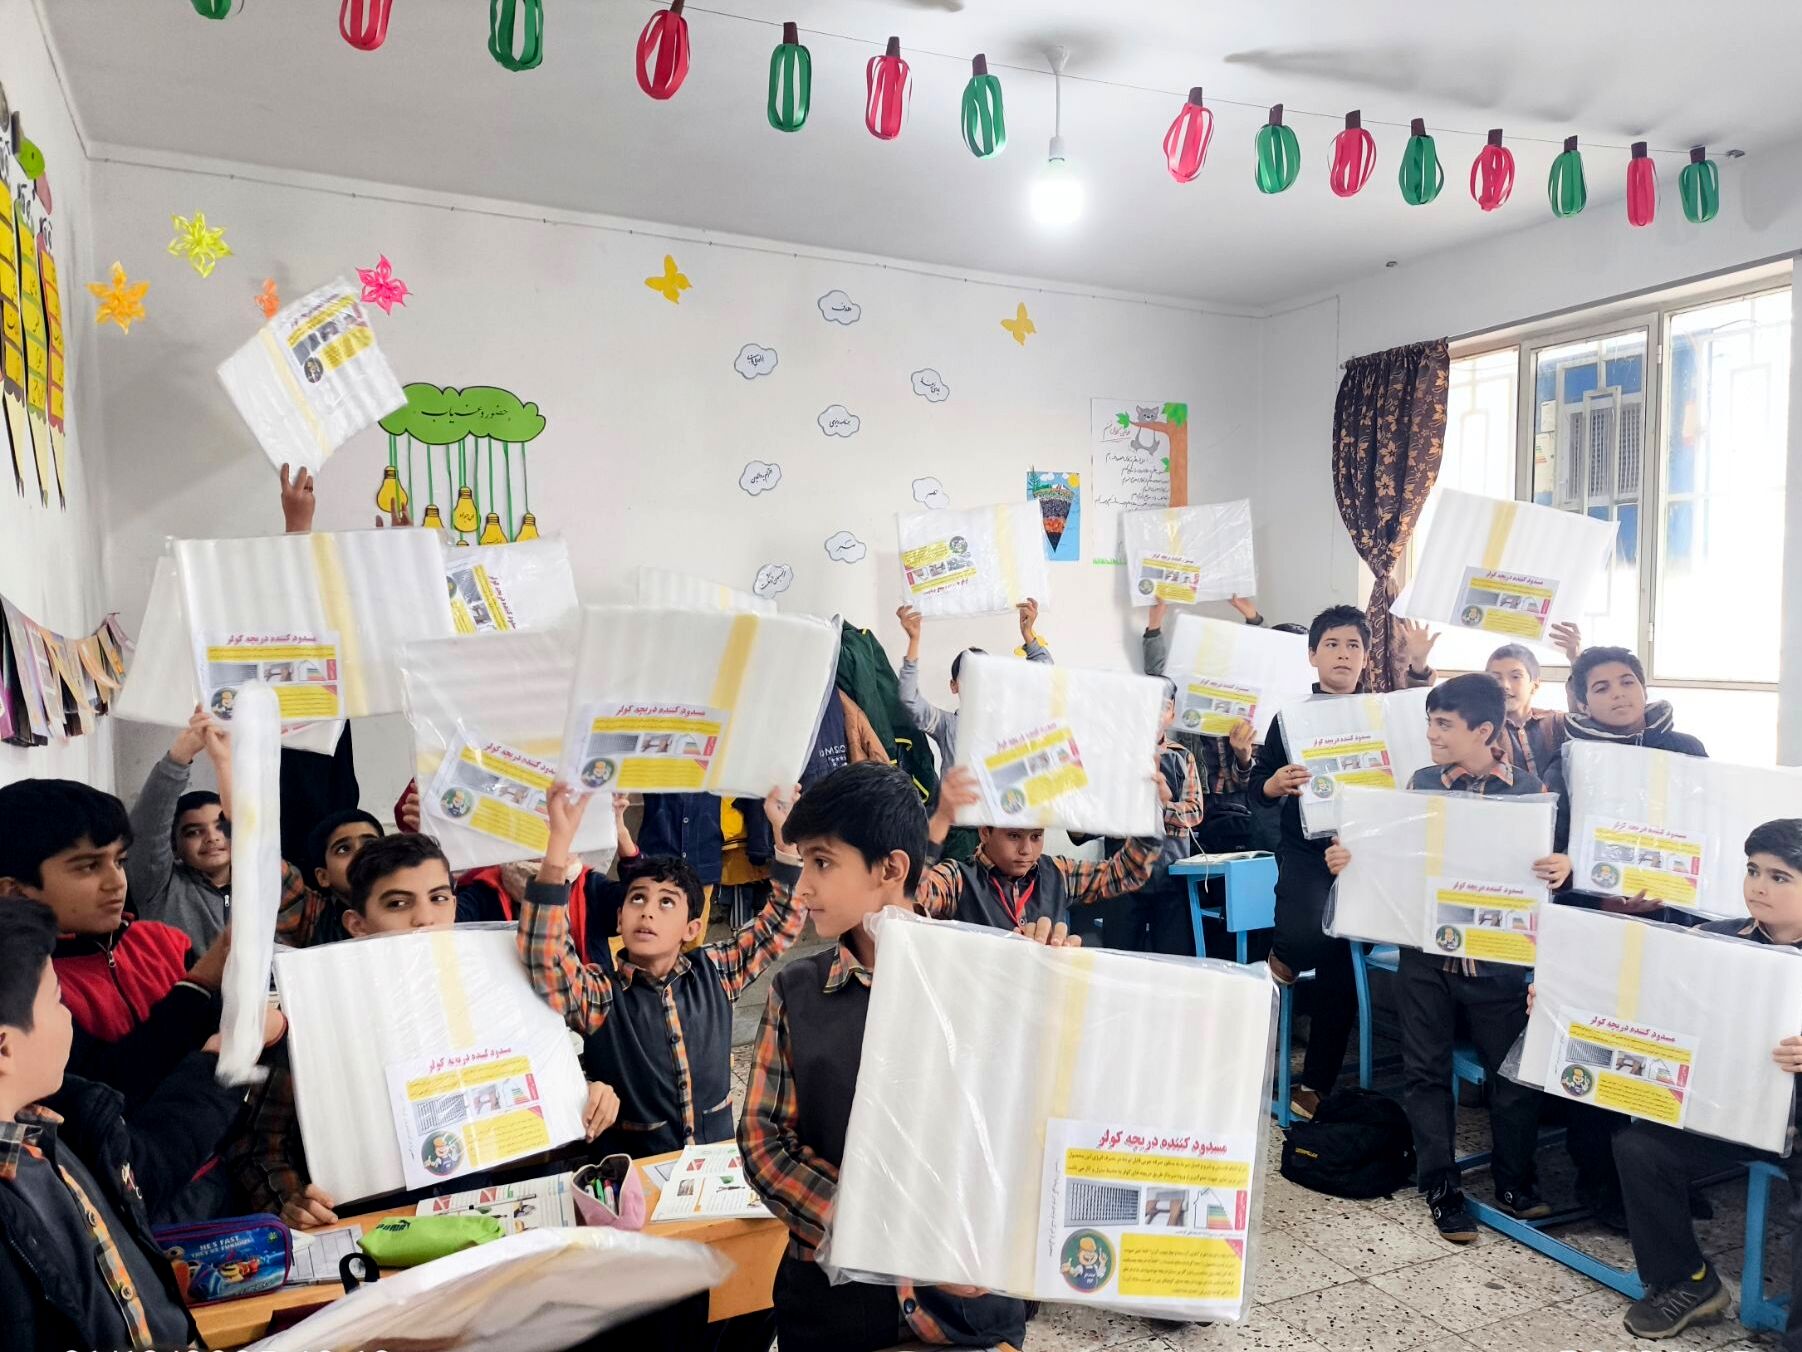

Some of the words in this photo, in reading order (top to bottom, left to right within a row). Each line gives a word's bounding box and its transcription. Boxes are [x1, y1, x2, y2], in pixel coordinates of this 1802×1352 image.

[616, 704, 633, 716] کولر
[634, 705, 657, 716] دریچه
[658, 706, 680, 715] کننده
[681, 709, 705, 721] مسدود
[1590, 1016, 1607, 1027] کولر
[1608, 1021, 1629, 1032] دریچه
[1629, 1026, 1651, 1036] کننده
[1651, 1031, 1676, 1044] مسدود
[1099, 1128, 1123, 1149] کولر
[1126, 1134, 1158, 1151] دریچه
[1161, 1137, 1190, 1151] کننده
[1192, 1140, 1227, 1155] مسدود
